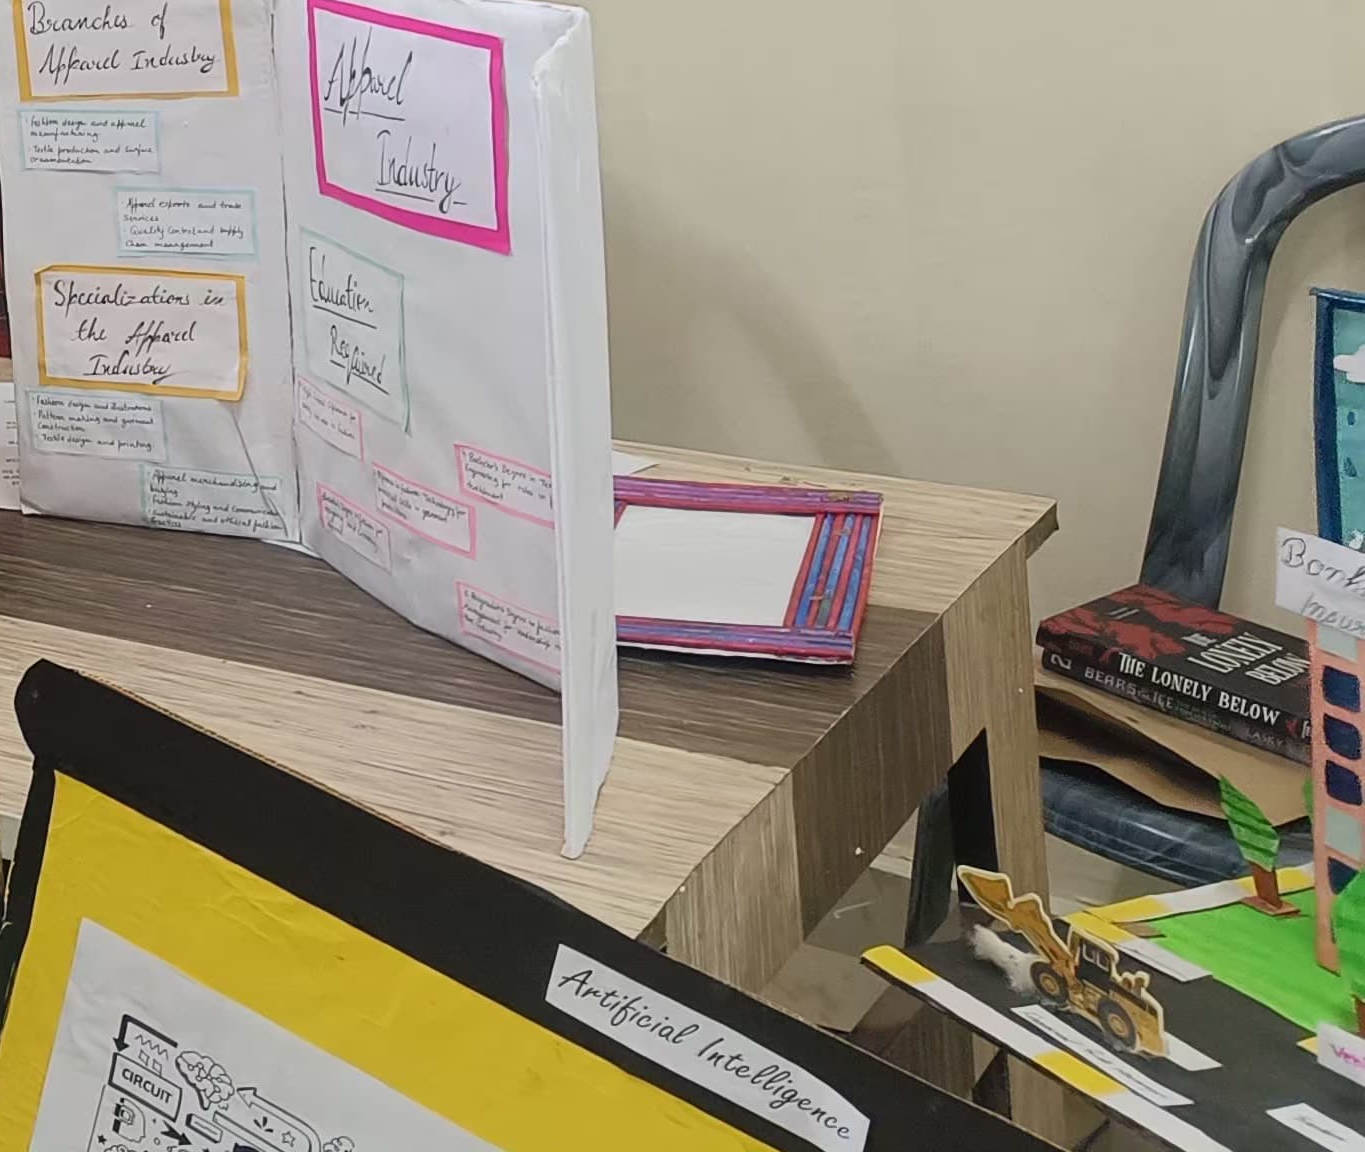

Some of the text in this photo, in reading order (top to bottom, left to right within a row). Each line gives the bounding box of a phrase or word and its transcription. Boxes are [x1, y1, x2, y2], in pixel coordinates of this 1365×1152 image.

[150, 1, 170, 41] of
[38, 42, 220, 86] Apparel Industry
[324, 25, 414, 128] Apparel
[375, 128, 463, 215] Industry
[198, 288, 226, 306] in
[71, 316, 198, 357] the Apparel
[83, 348, 185, 385] Industry
[1186, 631, 1286, 675] LONELY
[1243, 652, 1311, 686] BELOW
[1083, 665, 1138, 698] BEARS
[1118, 651, 1147, 679] THE
[1150, 665, 1213, 703] LONELY
[1216, 691, 1282, 728] BELOW
[556, 968, 852, 1141] Artificial Intelligence
[121, 1066, 174, 1106] CIRCUIT
